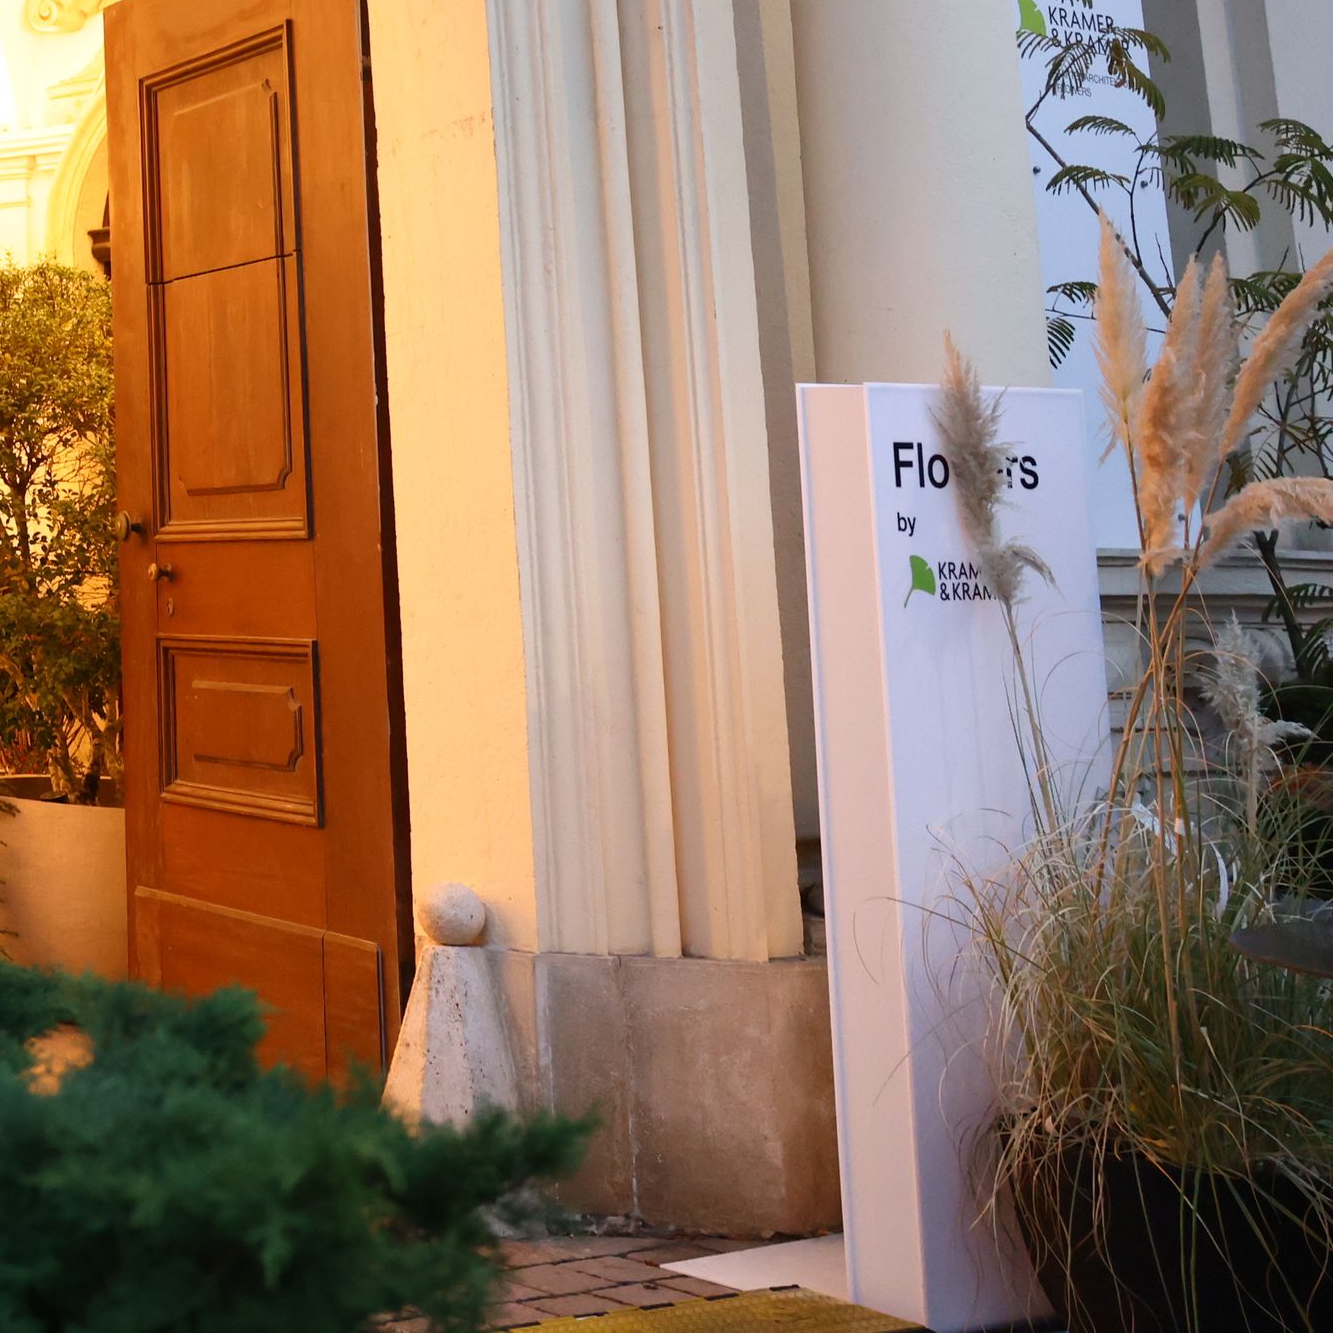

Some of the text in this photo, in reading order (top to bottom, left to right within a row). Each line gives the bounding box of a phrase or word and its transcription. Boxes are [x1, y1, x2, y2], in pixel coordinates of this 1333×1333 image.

[1048, 5, 1114, 33] KRAMER
[1064, 30, 1131, 58] KRAMR
[897, 512, 916, 537] by
[938, 561, 982, 580] KRAM
[940, 582, 950, 601] &
